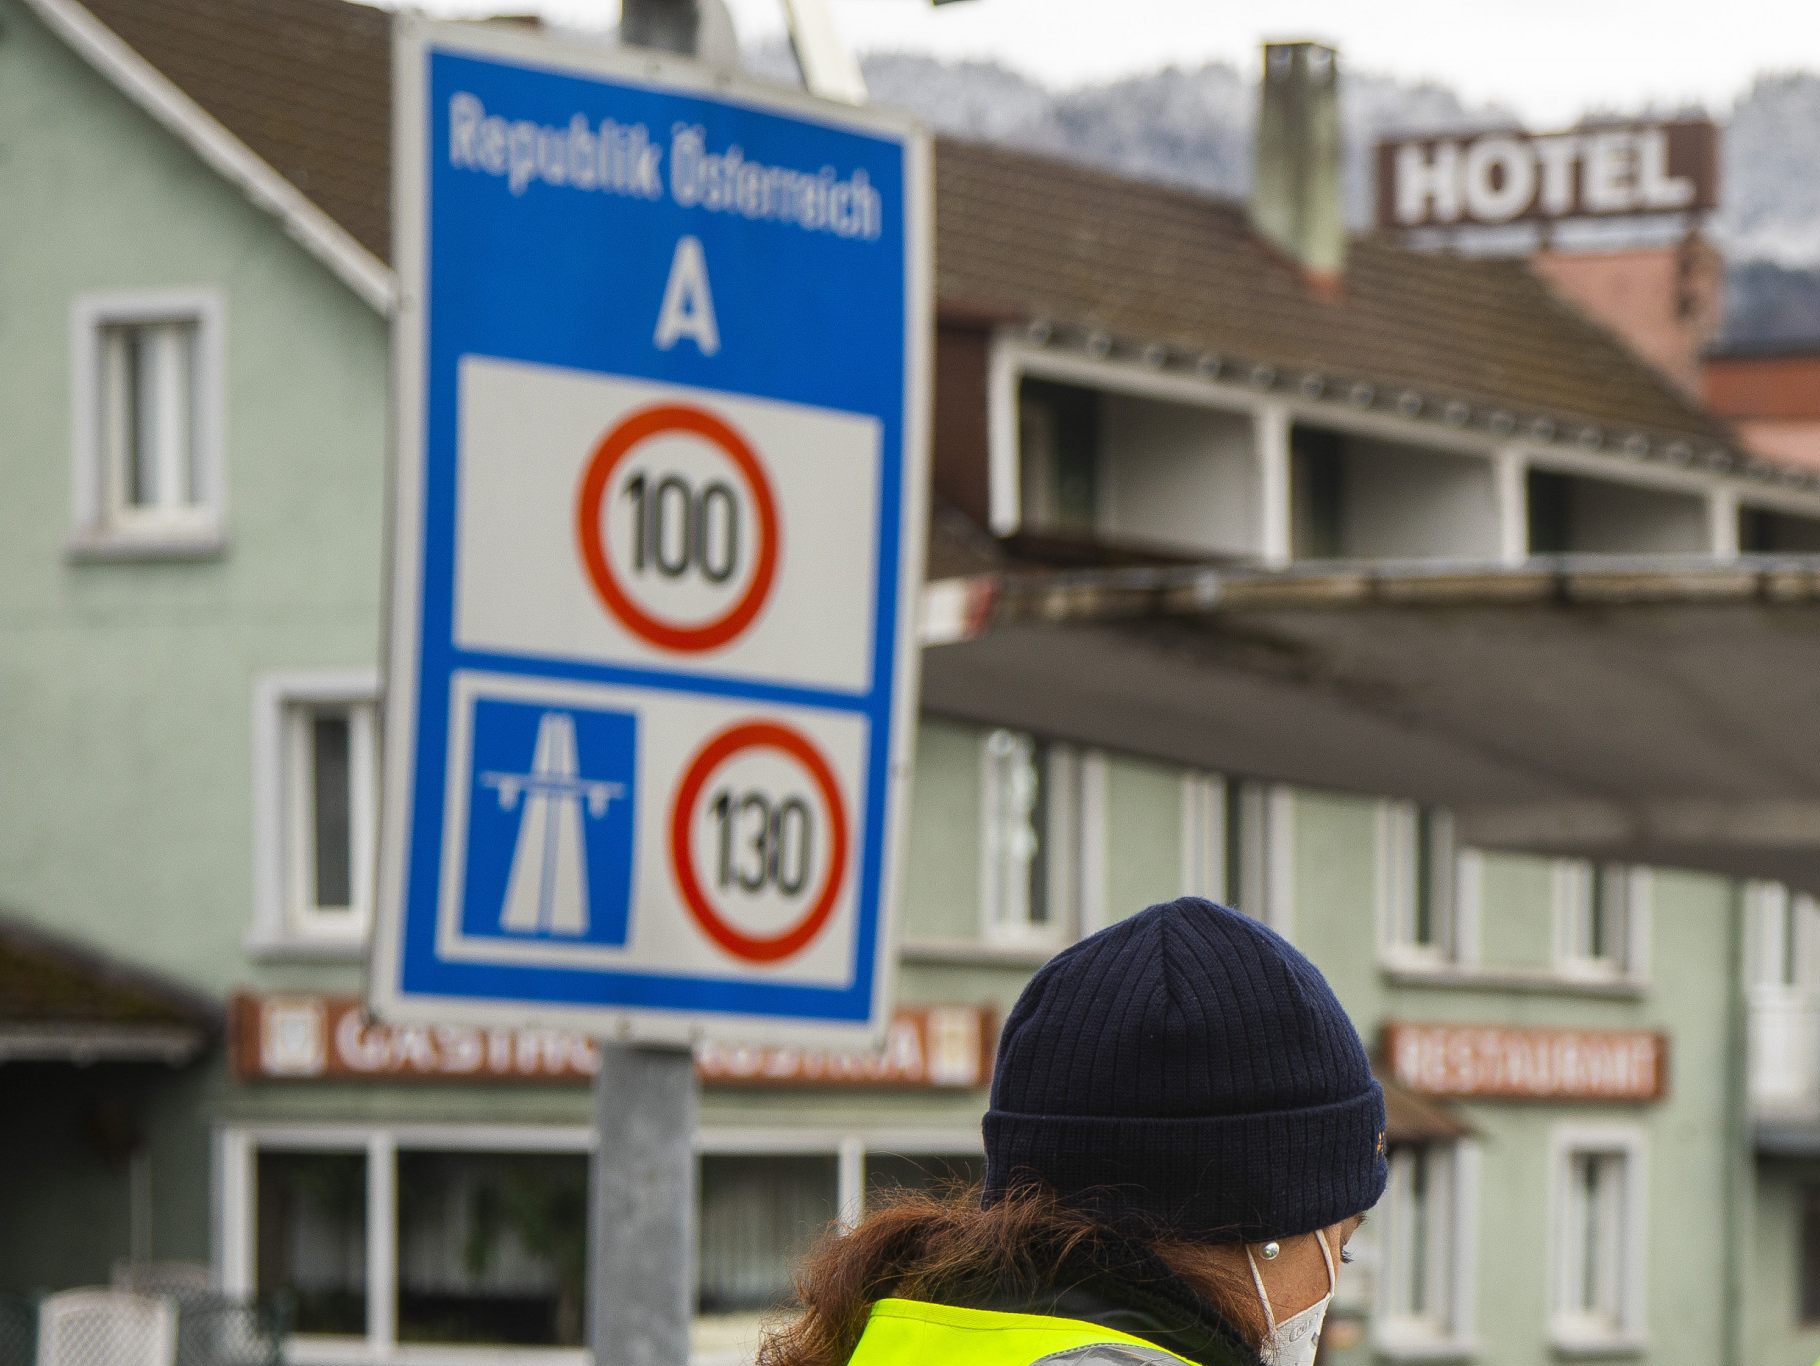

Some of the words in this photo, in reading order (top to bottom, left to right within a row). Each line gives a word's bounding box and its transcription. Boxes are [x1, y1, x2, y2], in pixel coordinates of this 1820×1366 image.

[449, 91, 662, 201] Republik
[669, 121, 882, 241] Österreich
[1394, 129, 1697, 224] HOTEL
[652, 234, 721, 357] A
[622, 468, 740, 584] 100
[708, 787, 816, 899] 130
[1394, 1026, 1655, 1093] RESTAURANT
